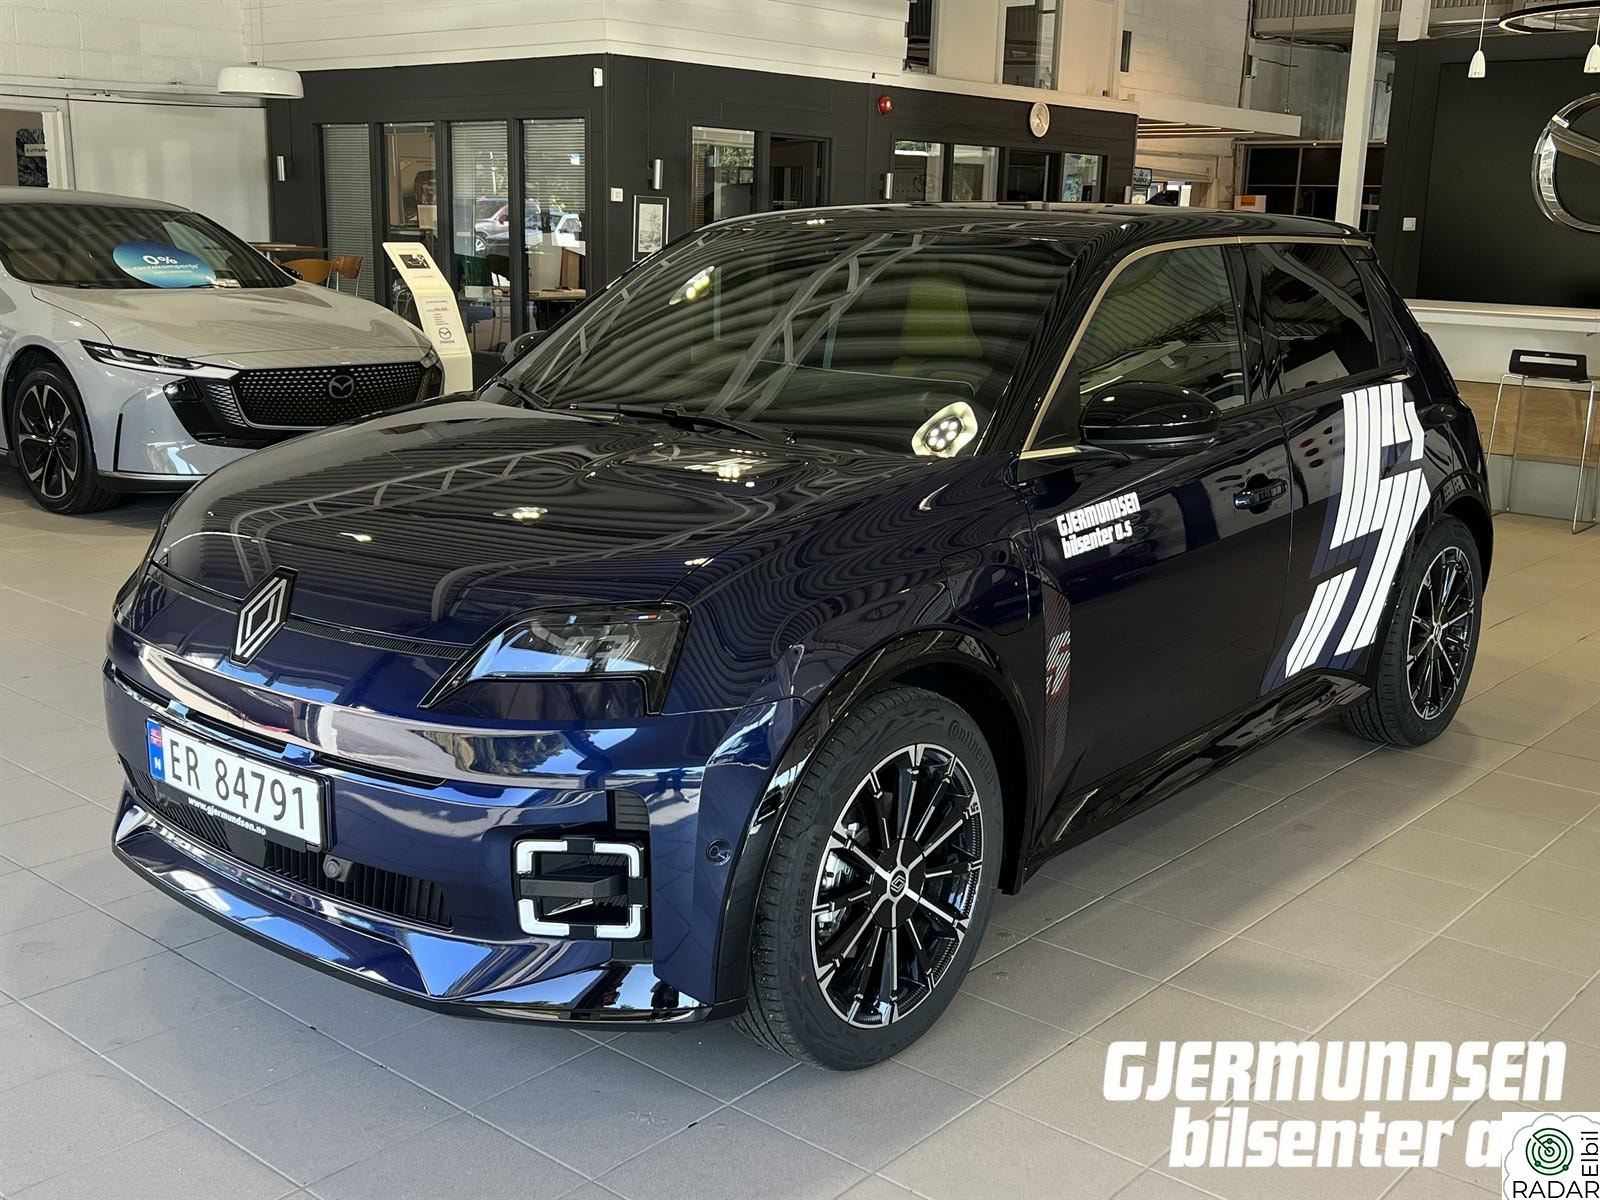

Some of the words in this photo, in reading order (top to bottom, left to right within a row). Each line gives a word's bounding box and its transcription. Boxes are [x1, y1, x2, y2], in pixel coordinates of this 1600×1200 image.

[142, 254, 178, 265] 0%
[1056, 491, 1141, 537] GJERMUNDSEN
[1061, 527, 1114, 559] bilsenter
[169, 739, 201, 791] ER
[214, 757, 305, 831] 84791
[188, 796, 267, 837] www.gjermundsen.no
